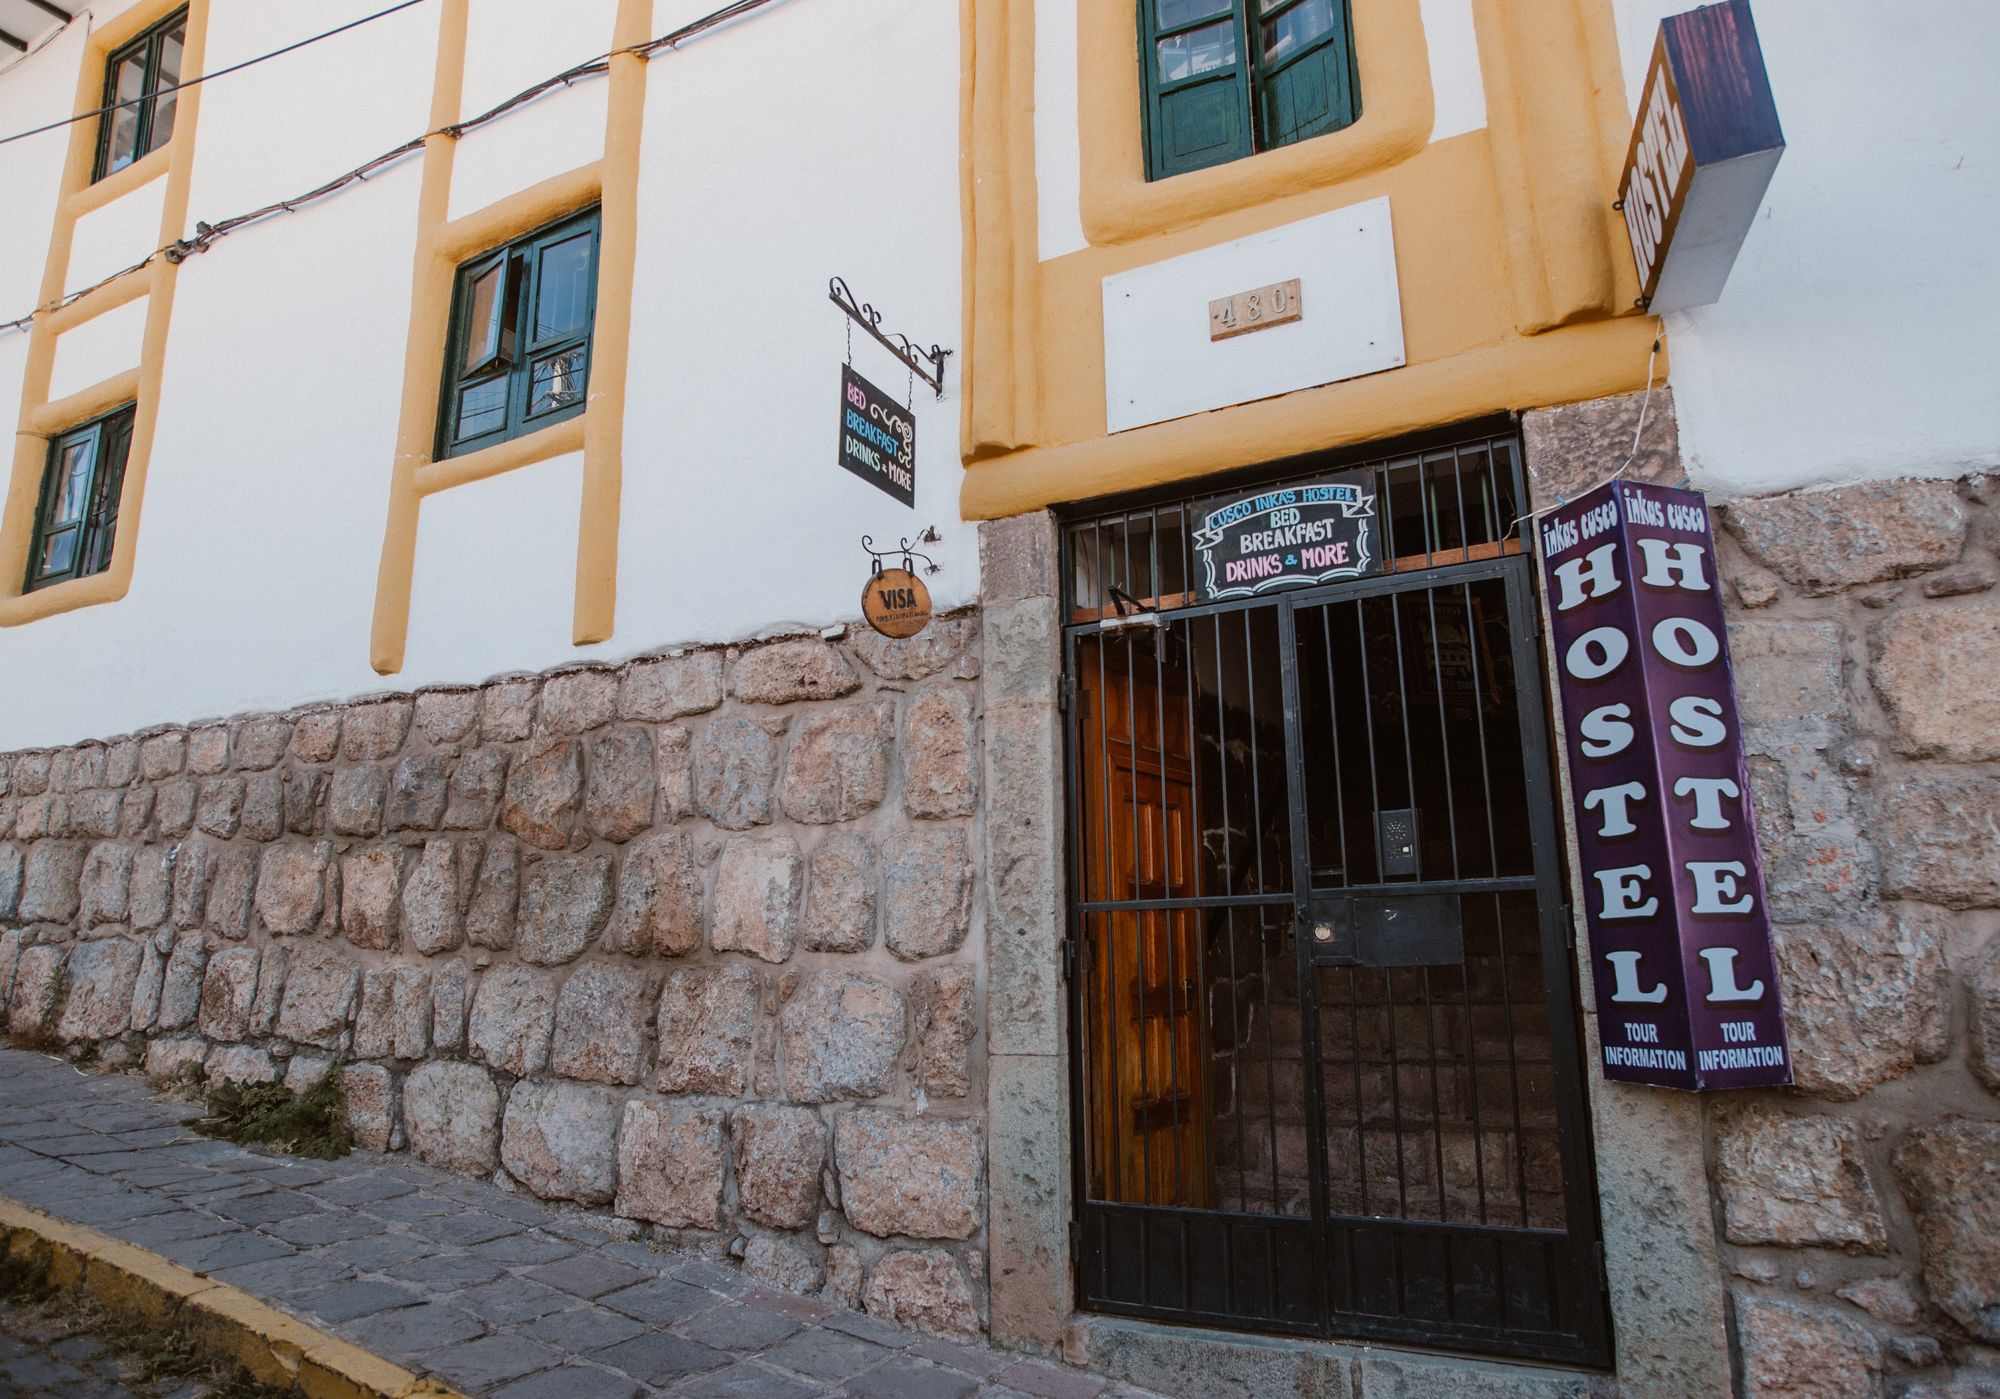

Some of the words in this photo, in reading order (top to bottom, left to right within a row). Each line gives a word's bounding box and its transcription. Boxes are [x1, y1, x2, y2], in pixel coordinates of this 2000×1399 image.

[1624, 64, 1688, 291] HOSTEL
[1221, 287, 1286, 328] 480
[847, 382, 867, 410] BED
[846, 407, 899, 458] BREAKFAST
[845, 433, 881, 472] DRINKS
[888, 461, 912, 492] MORE
[1210, 502, 1252, 529] CUSCO
[1302, 487, 1354, 503] HOSTEL
[1270, 507, 1301, 529] BED
[1623, 488, 1665, 528] inkas
[1667, 504, 1705, 533] cusco
[1240, 518, 1335, 554] BREAKFAST
[1543, 517, 1579, 558] inkas
[1580, 500, 1618, 540] cusco
[1225, 553, 1283, 583] DRINKS
[1284, 553, 1298, 566] &
[1301, 541, 1350, 570] MORE
[878, 587, 917, 610] VISA
[1553, 542, 1668, 1004] HOSTEL
[1636, 537, 1765, 1003] HOSTEL
[1624, 1022, 1659, 1043] TOUR
[1720, 1021, 1757, 1043] TOUR
[1604, 1045, 1687, 1071] INFORMATION
[1698, 1045, 1784, 1071] INFORMATION
